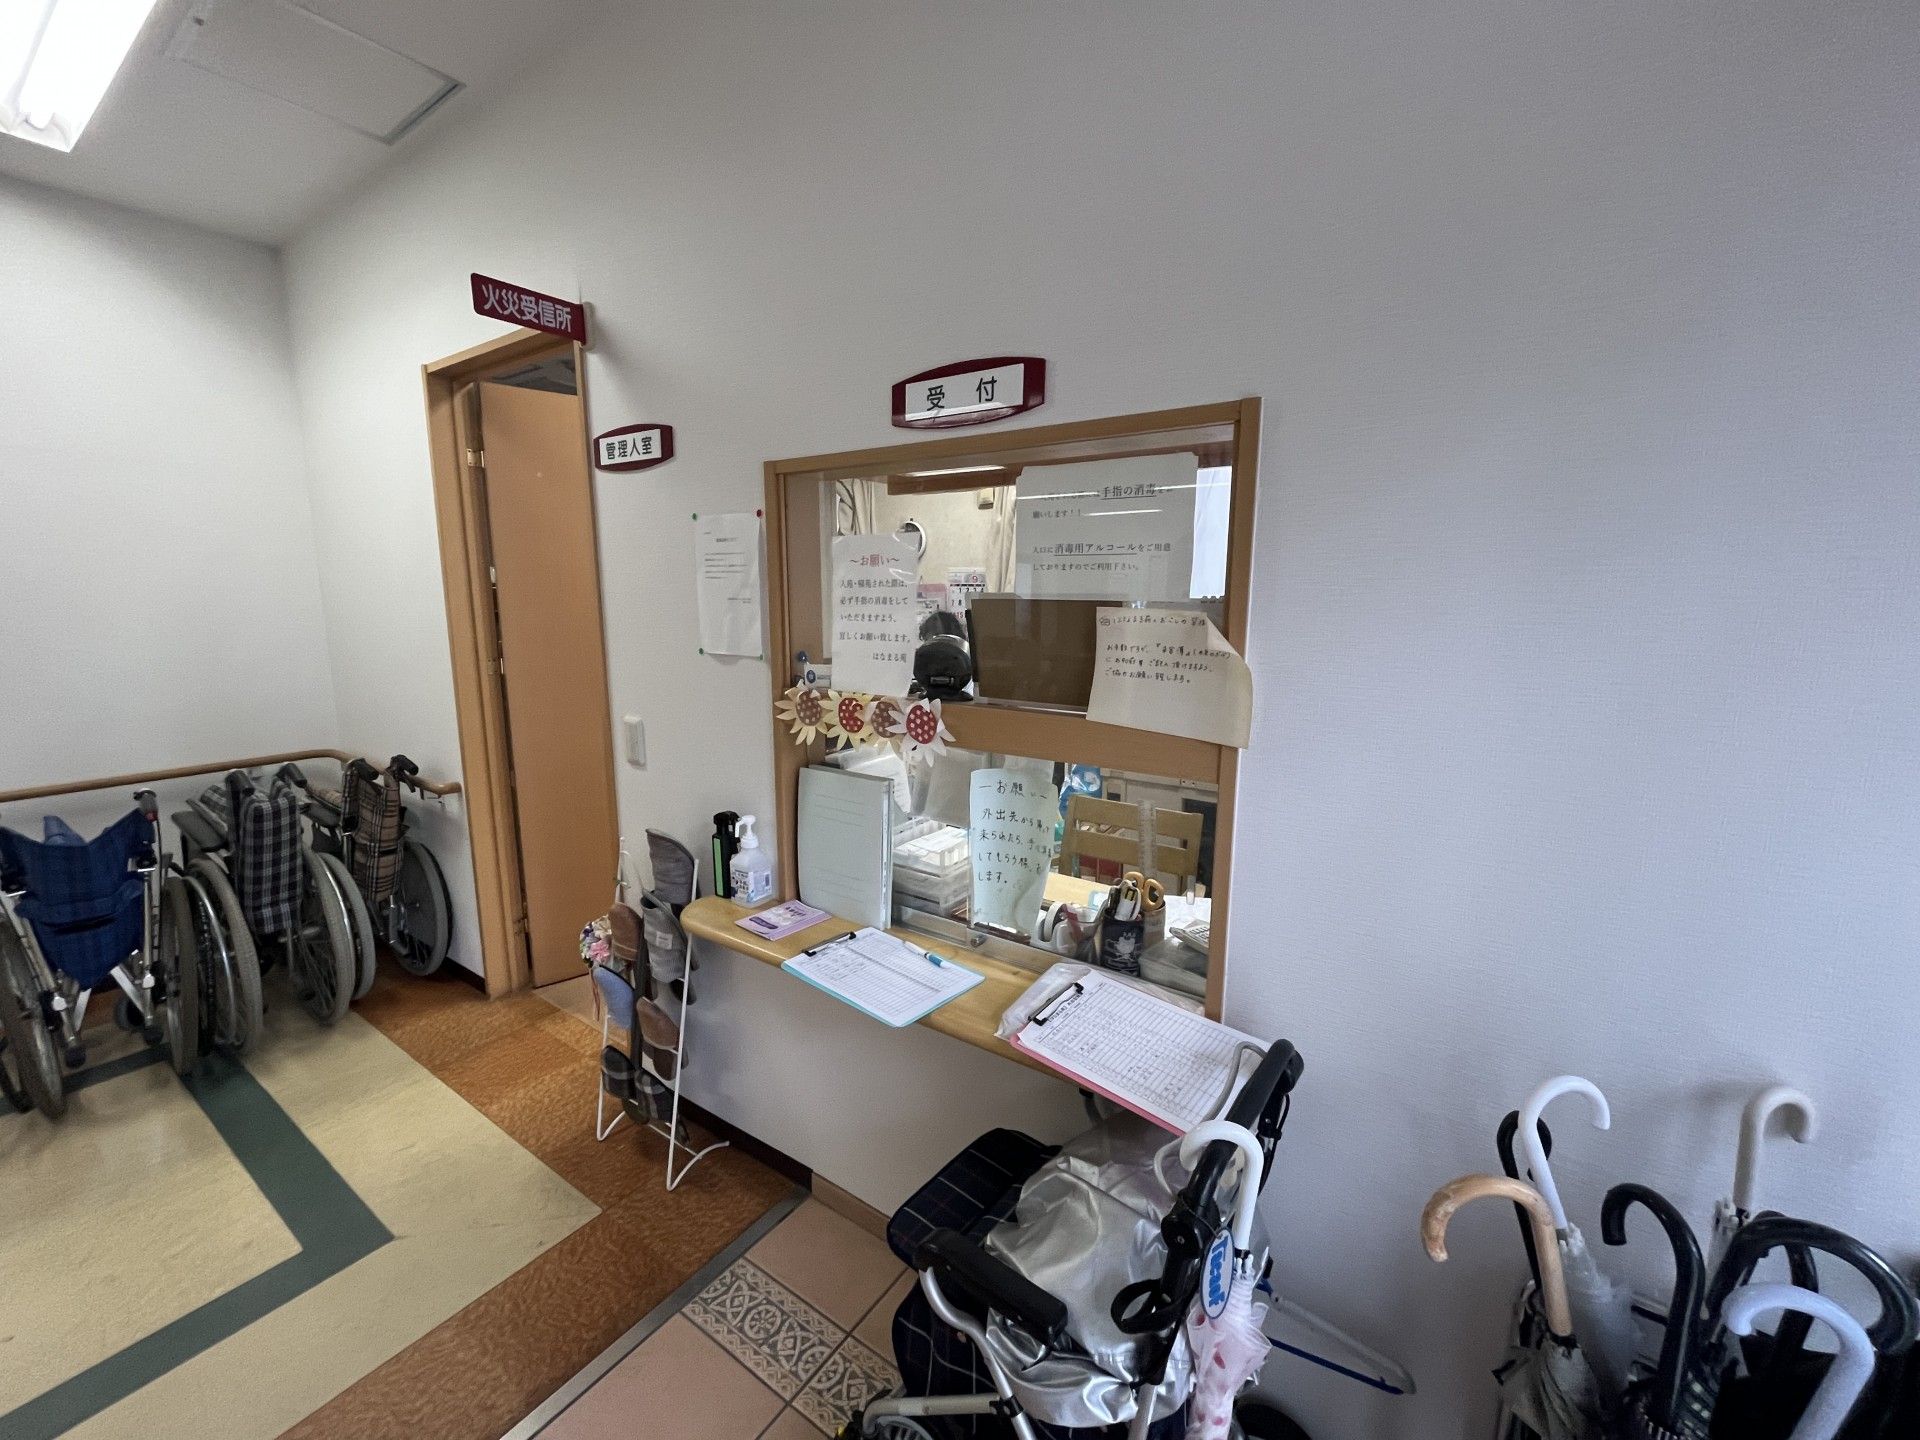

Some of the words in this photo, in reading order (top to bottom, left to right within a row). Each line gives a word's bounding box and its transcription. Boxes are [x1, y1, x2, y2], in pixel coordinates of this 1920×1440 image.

[481, 284, 572, 333] 火災受信所
[926, 375, 997, 411] 受付
[605, 436, 652, 460] 管理人室
[840, 612, 897, 623] いただきますよう、
[978, 870, 1007, 884] します。
